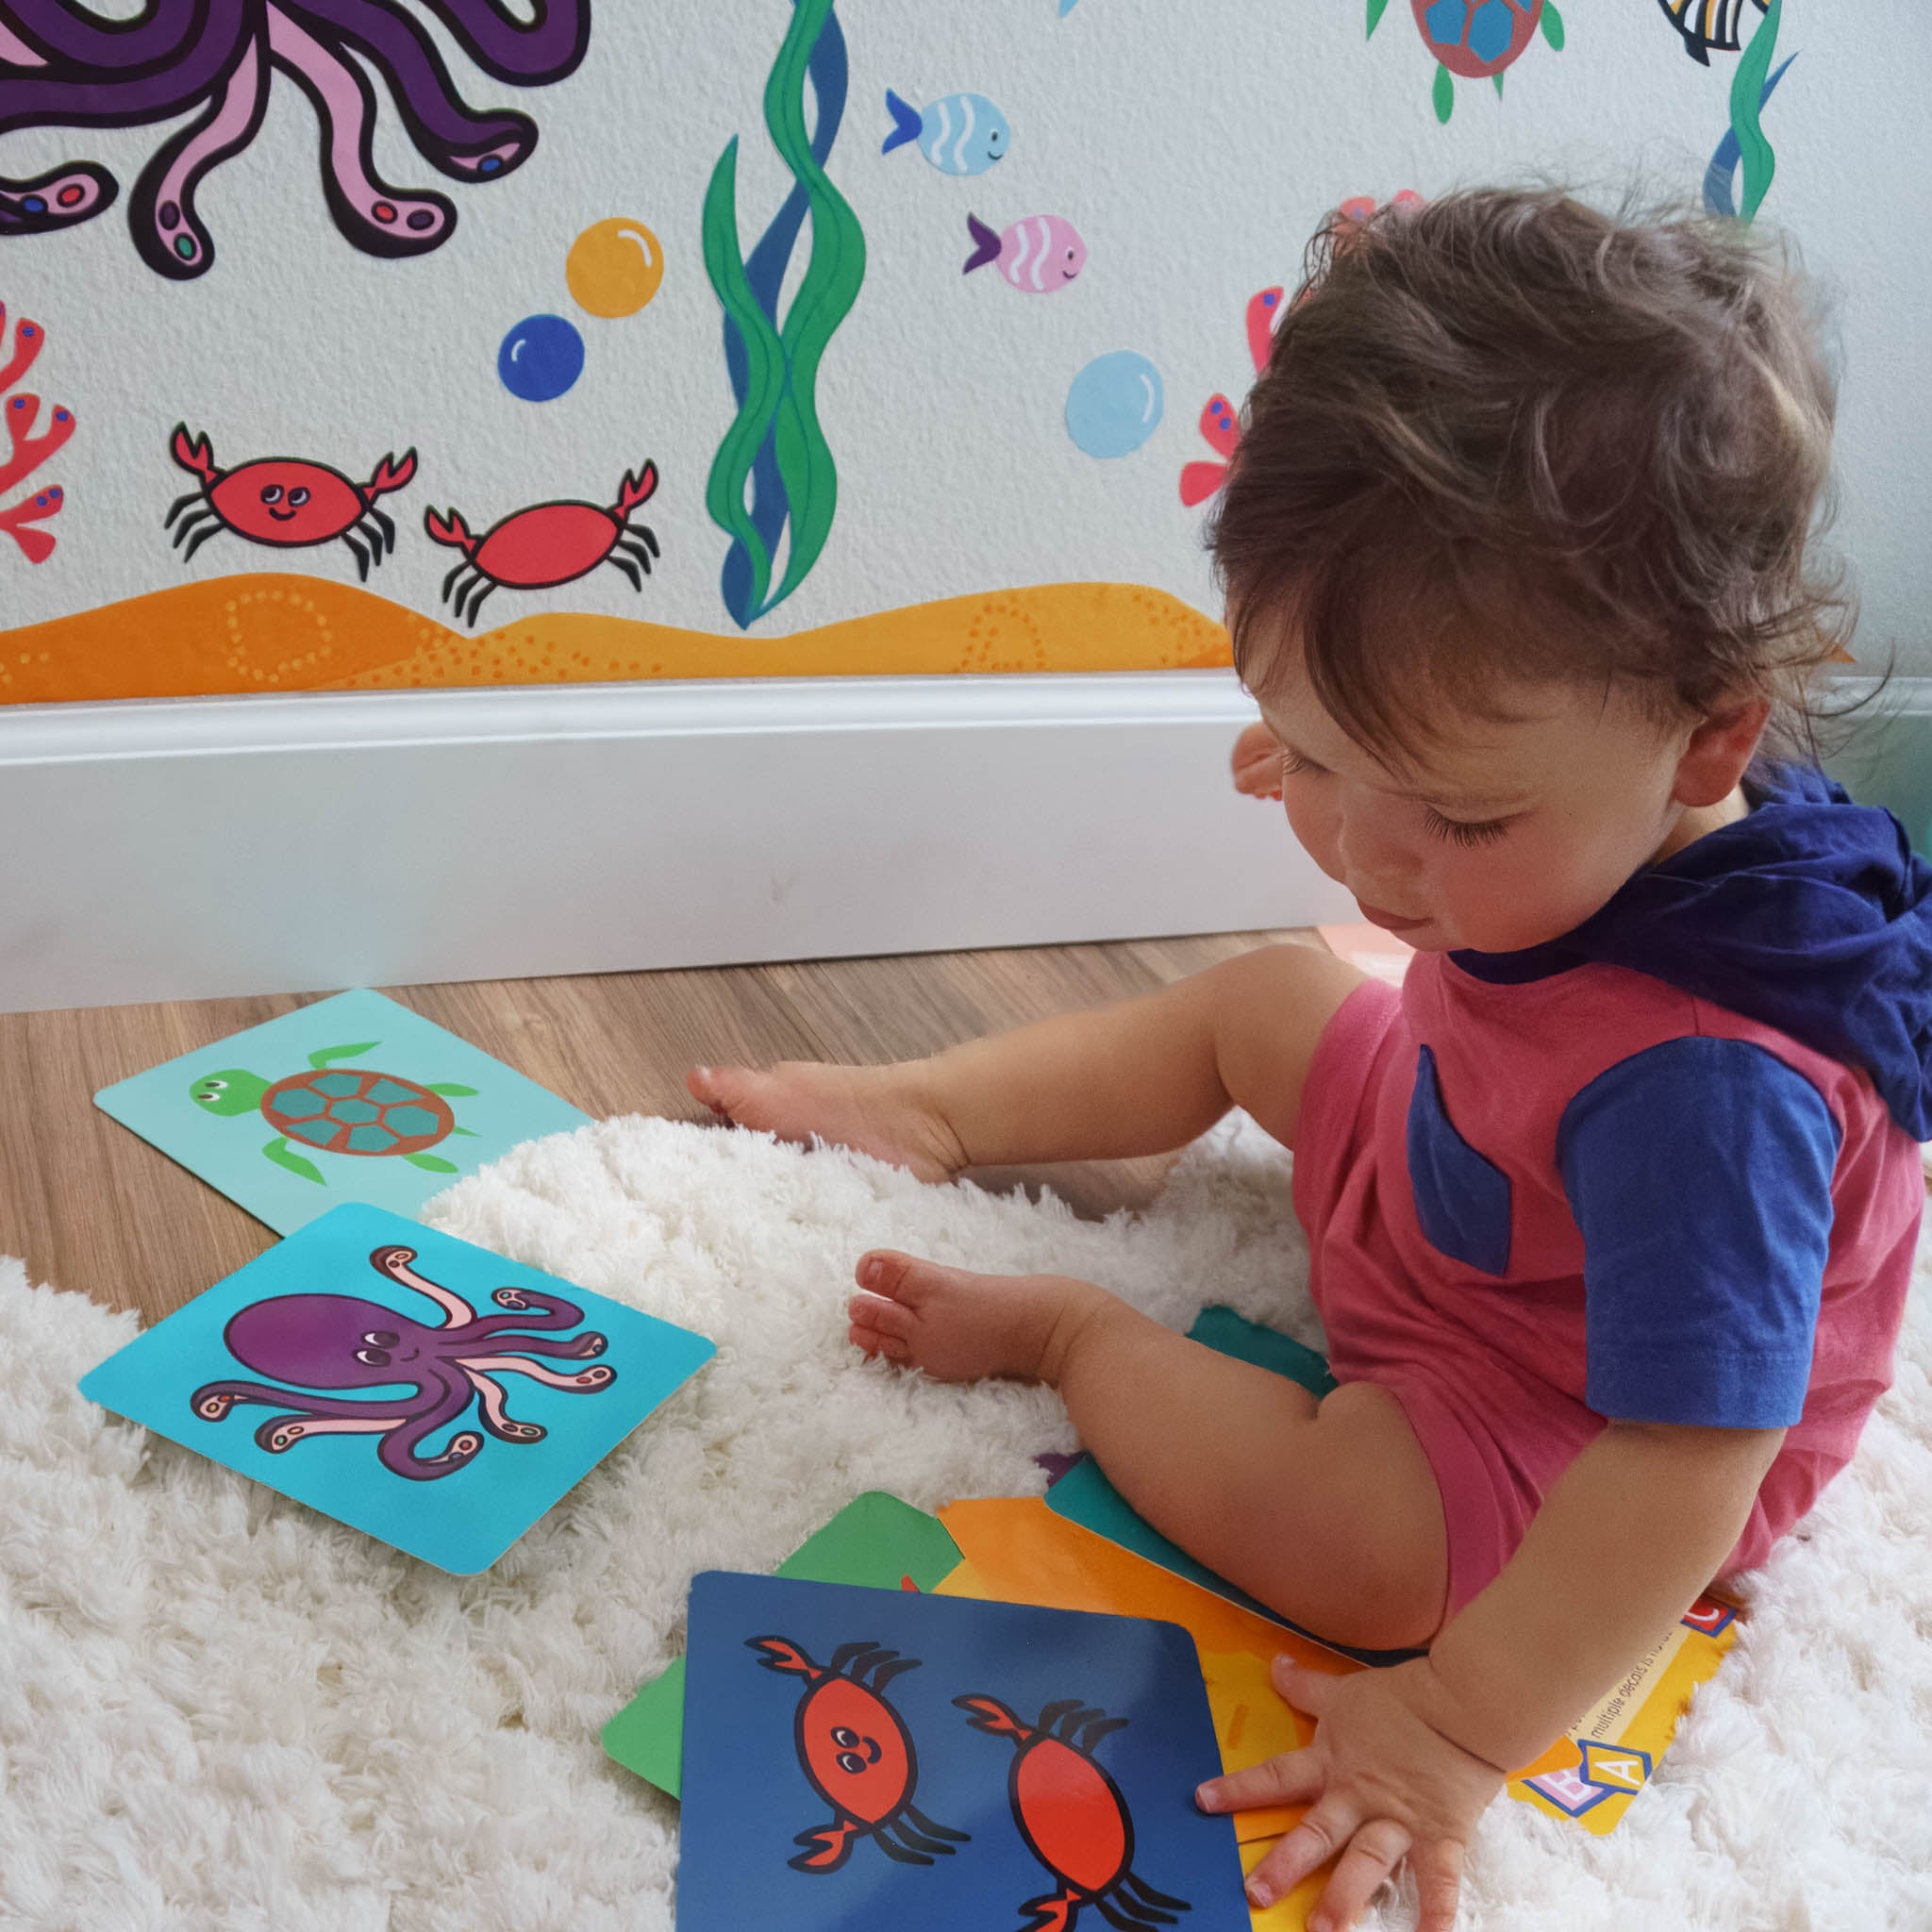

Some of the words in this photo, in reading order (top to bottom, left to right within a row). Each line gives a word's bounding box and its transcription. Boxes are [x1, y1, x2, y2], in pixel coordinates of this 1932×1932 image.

[1591, 1697, 1624, 1739] multiple
[1540, 1769, 1591, 1802] B
[1594, 1759, 1641, 1786] A
